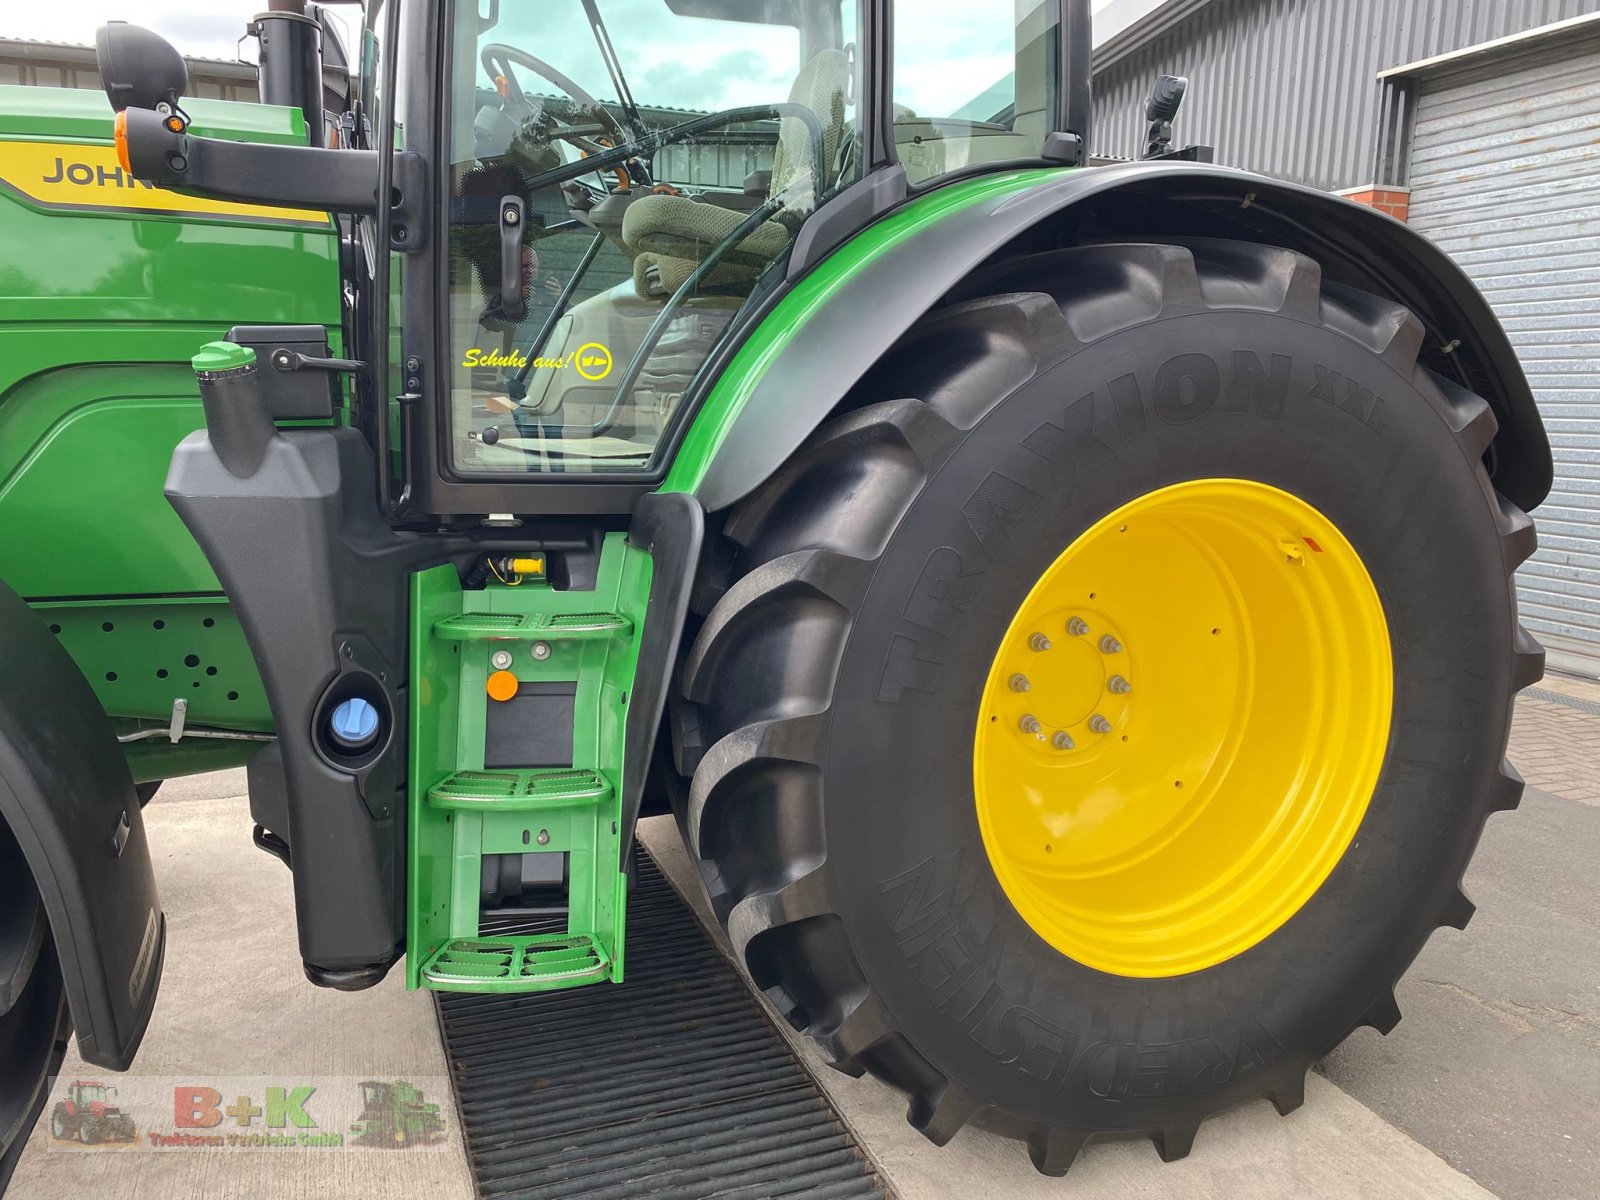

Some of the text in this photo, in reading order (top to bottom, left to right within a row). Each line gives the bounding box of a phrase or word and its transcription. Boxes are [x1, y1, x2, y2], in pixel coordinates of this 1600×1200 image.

[462, 348, 575, 369] Schuhe aus!
[875, 350, 1387, 705] TRAXION XXL
[876, 855, 1290, 1102] VREDESTEIN
